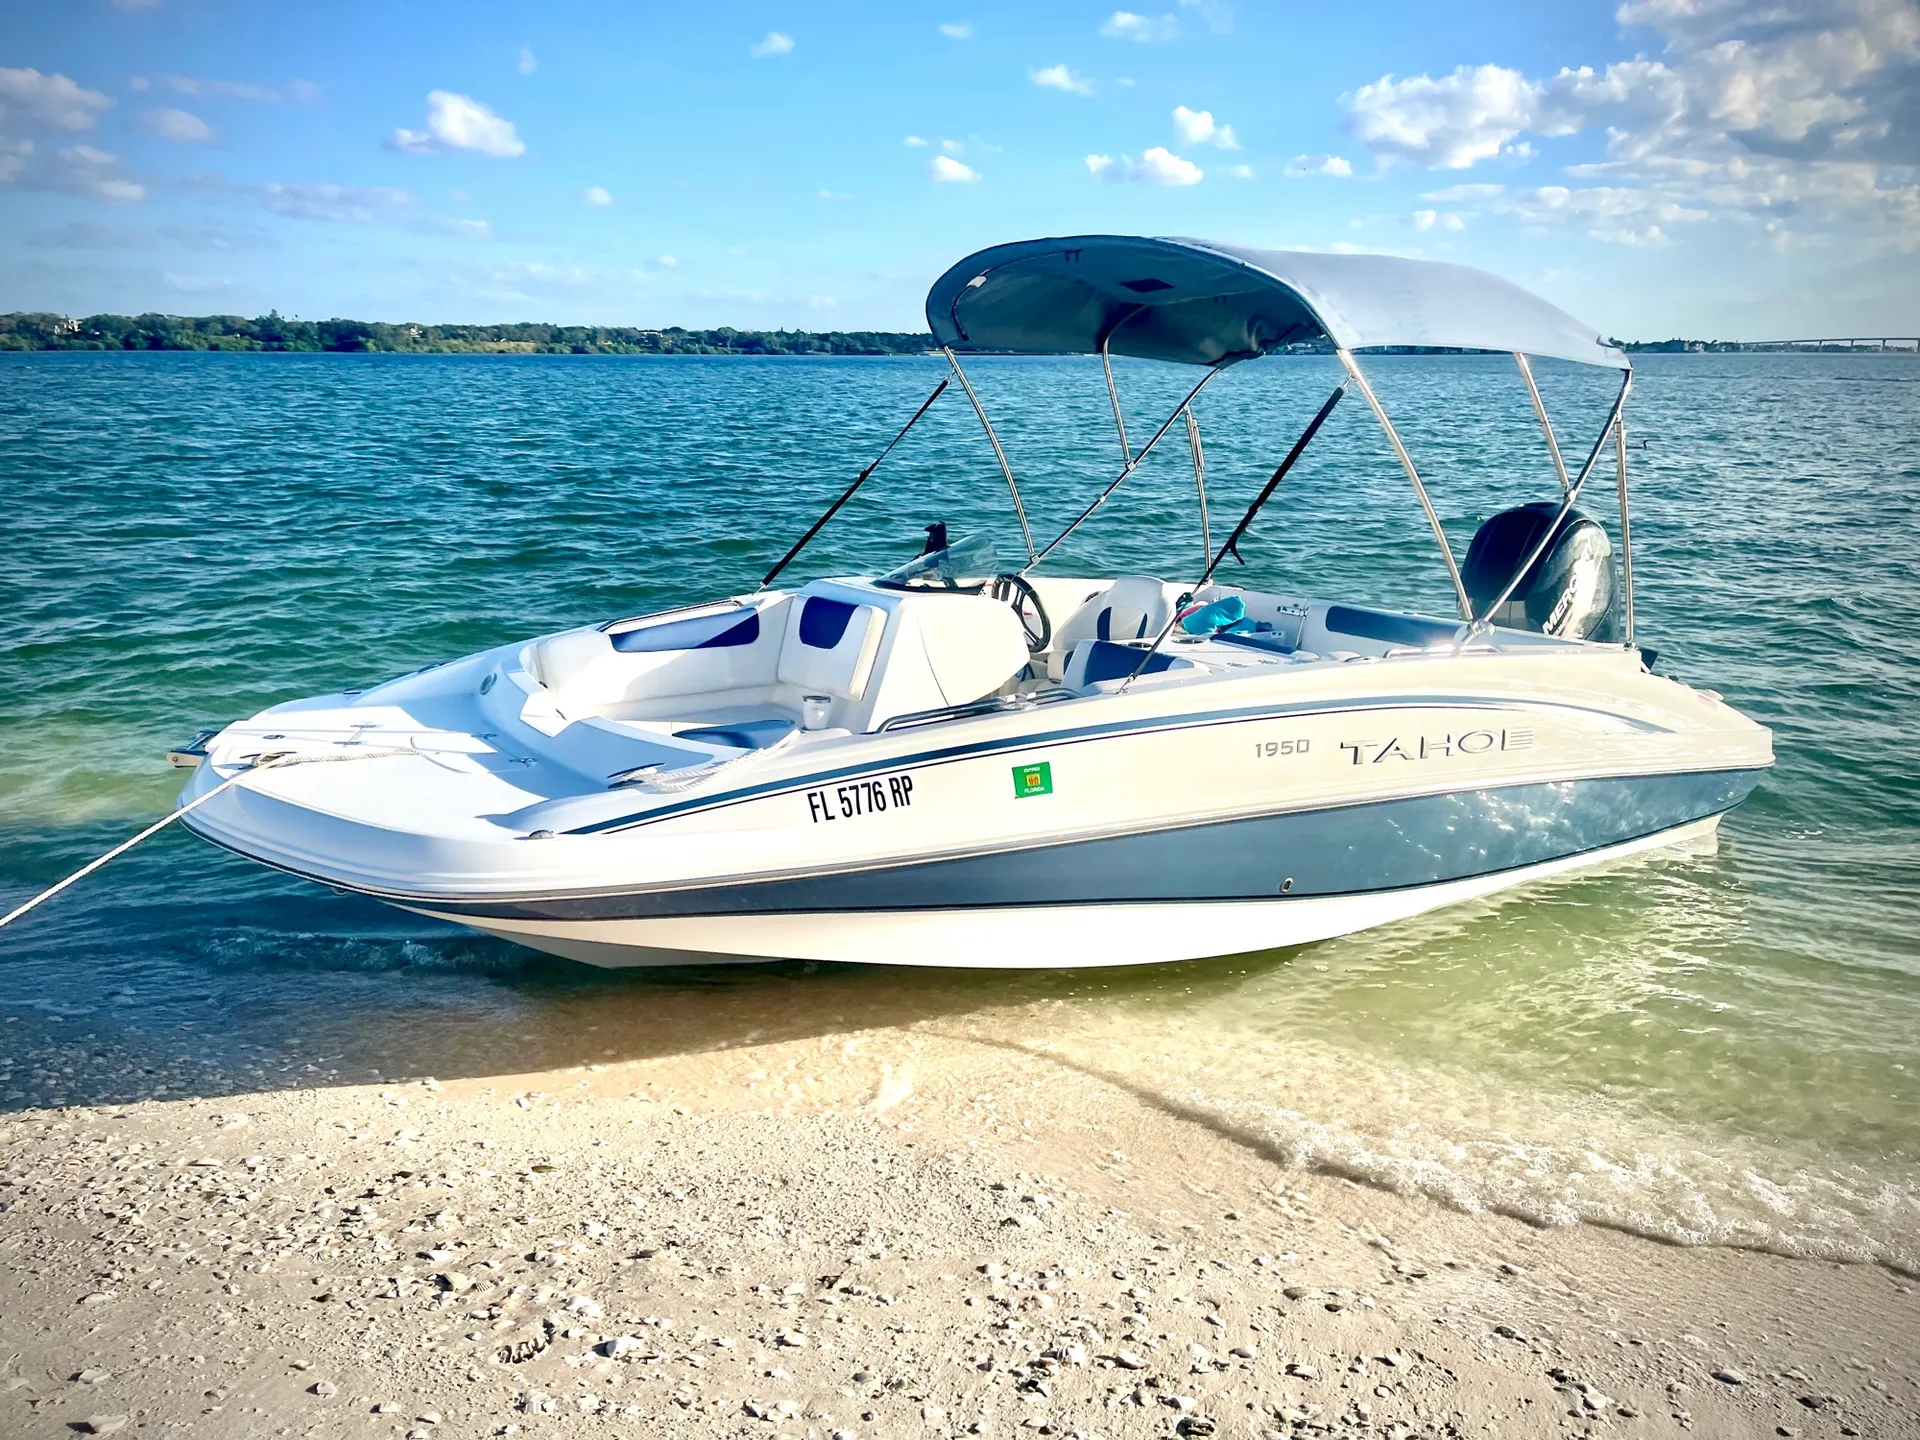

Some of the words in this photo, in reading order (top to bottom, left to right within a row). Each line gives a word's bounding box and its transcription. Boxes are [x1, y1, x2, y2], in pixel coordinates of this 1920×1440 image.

[1255, 739, 1310, 758] 1950
[1340, 727, 1534, 765] TAHOE
[807, 792, 836, 824] FL
[838, 780, 887, 818] 5776
[888, 775, 914, 808] RP
[1024, 786, 1045, 794] FLORIDA
